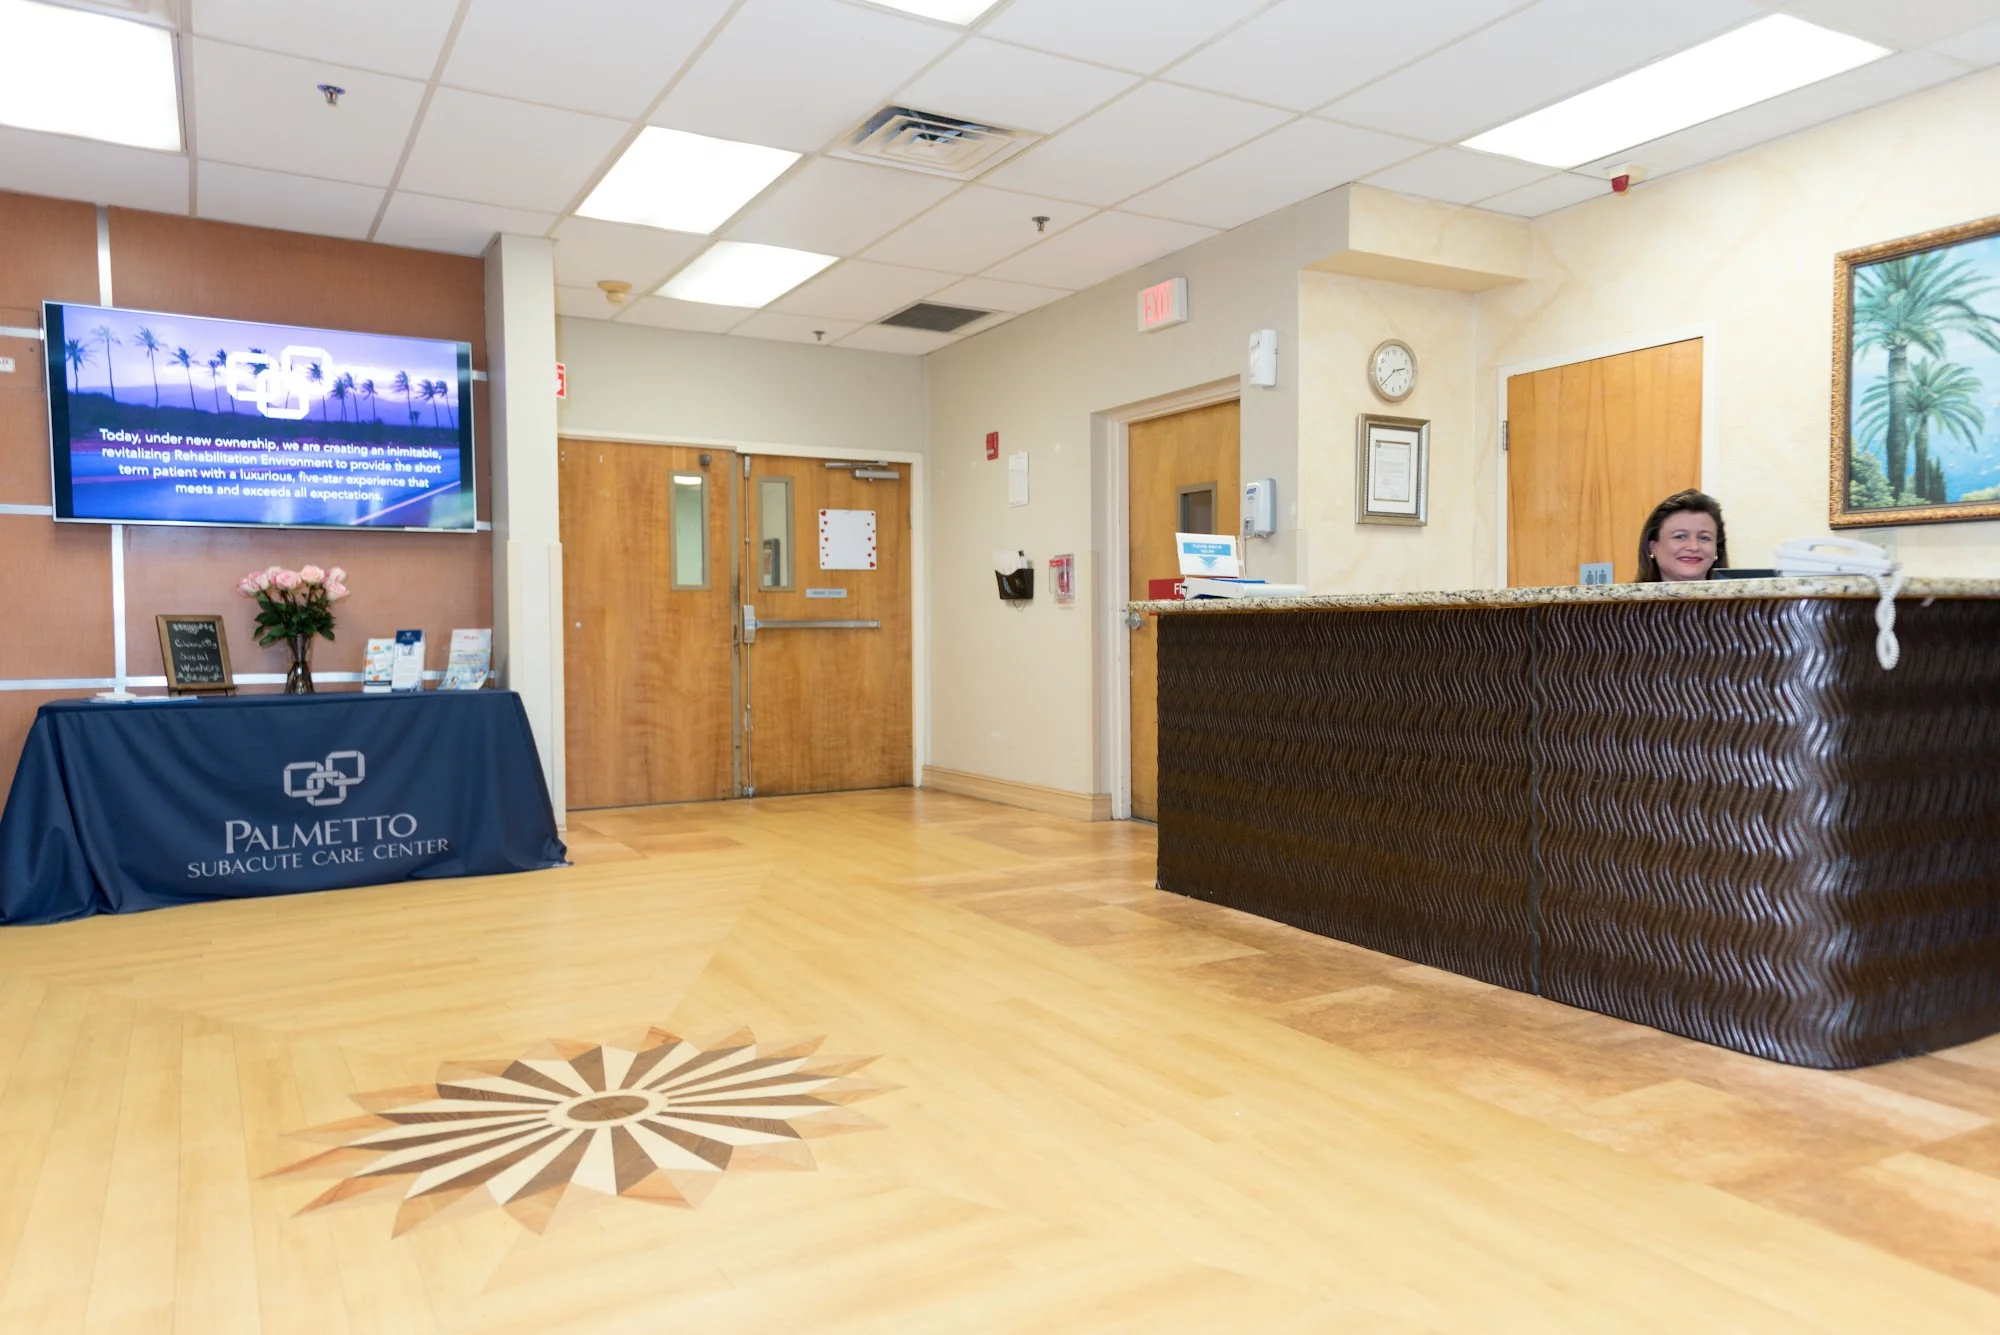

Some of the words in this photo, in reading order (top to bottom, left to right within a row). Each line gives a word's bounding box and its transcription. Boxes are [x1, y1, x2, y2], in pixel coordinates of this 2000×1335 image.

[1144, 280, 1172, 326] EXIT
[99, 428, 141, 445] Today,
[145, 432, 183, 445] under
[186, 435, 211, 447] new
[215, 437, 279, 451] ownership,
[283, 441, 300, 452] we
[303, 442, 320, 453] are
[323, 444, 368, 458] creating
[371, 446, 385, 457] an
[387, 445, 442, 460] inimitable,
[102, 447, 171, 463] revitalizing
[174, 449, 257, 465] Rehabilitation
[261, 454, 333, 469] Environment
[335, 459, 348, 470] to
[350, 459, 391, 473] provide
[394, 459, 412, 473] the
[414, 462, 442, 474] short
[118, 464, 149, 476] term
[153, 465, 198, 480] patient
[200, 467, 226, 480] with
[229, 470, 237, 480] a
[240, 468, 295, 484] luxurious,
[299, 471, 343, 485] five-star
[346, 473, 405, 488] experience
[408, 476, 429, 489] that
[175, 484, 214, 495] meets
[217, 484, 240, 496] and
[243, 485, 291, 498] exceeds
[294, 486, 307, 499] all
[310, 488, 384, 502] expectations.
[225, 813, 417, 854] PALMETTO
[187, 853, 302, 878] SUBACUTE
[312, 847, 364, 866] CARE
[373, 838, 449, 859] CENTER
